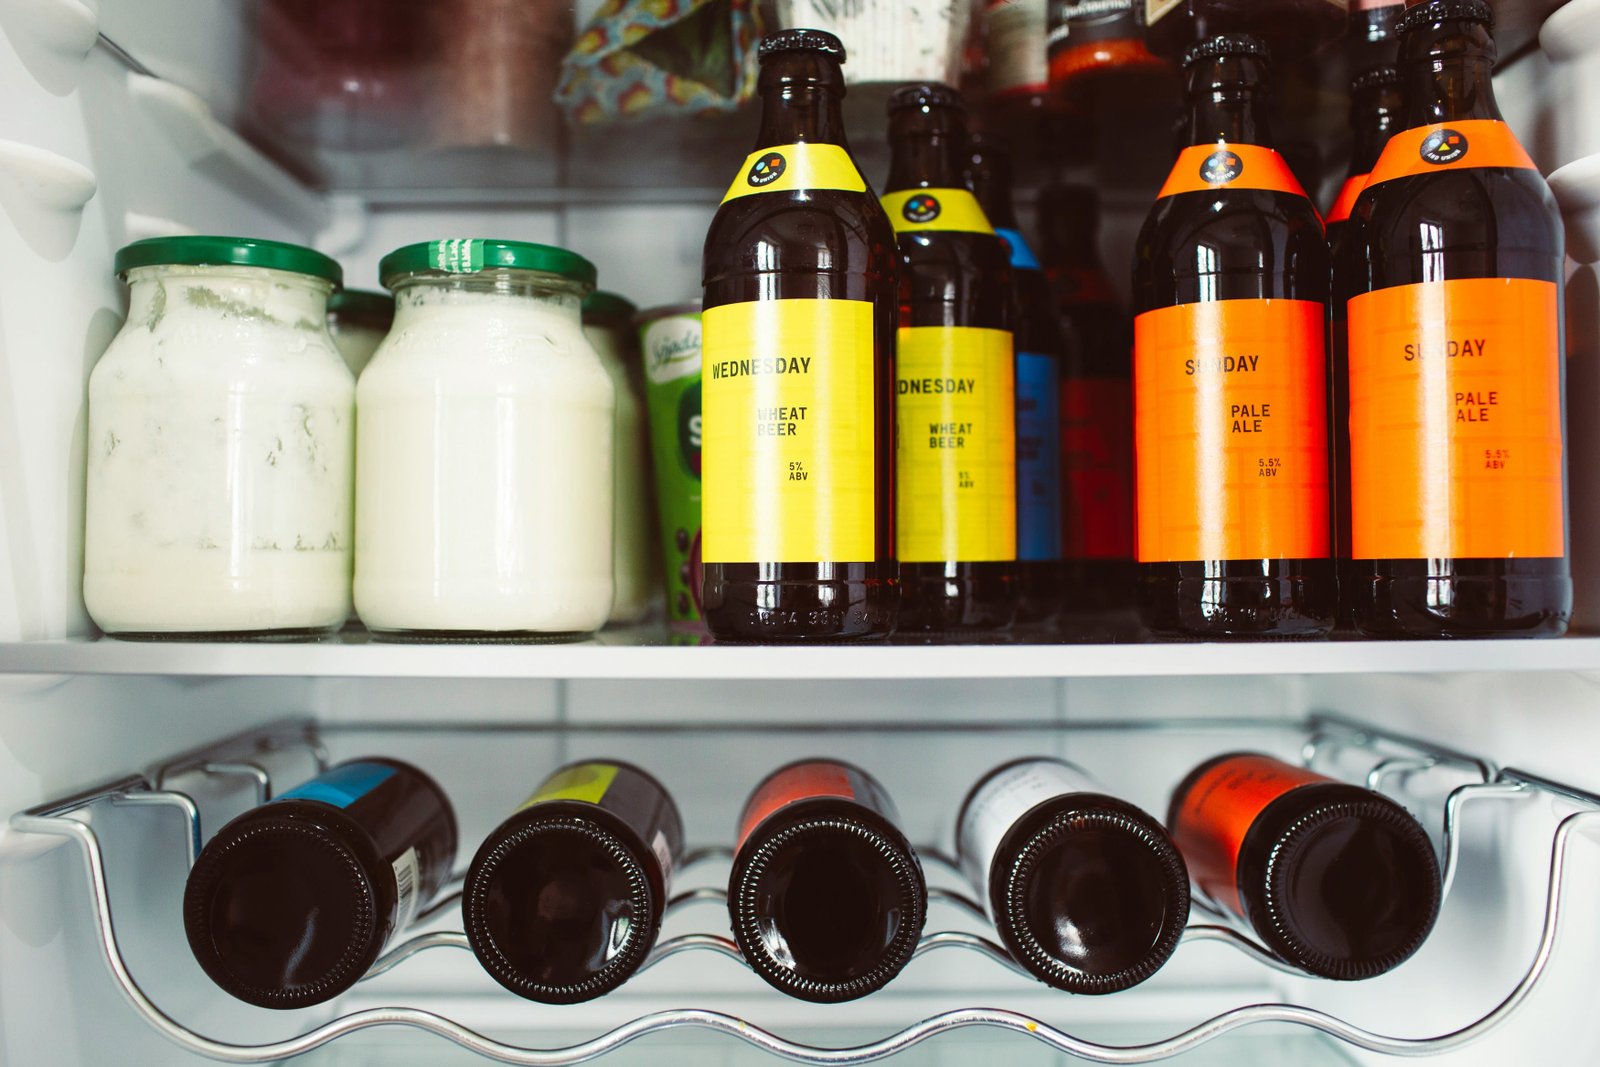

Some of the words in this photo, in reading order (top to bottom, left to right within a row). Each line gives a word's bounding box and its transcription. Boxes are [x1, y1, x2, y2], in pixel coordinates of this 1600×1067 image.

[1404, 339, 1486, 361] SDAY
[712, 357, 811, 379] WEDNESDAY
[1185, 355, 1259, 375] SDAY
[897, 379, 975, 394] DNESDAY
[1455, 391, 1498, 406] PALE
[757, 407, 807, 420] WHEAT
[1231, 404, 1270, 418] PALE
[1456, 408, 1489, 422] ALE
[757, 423, 796, 436] BEER
[929, 423, 973, 434] WHEAT
[1232, 420, 1262, 433] ALE
[929, 437, 964, 448] BEER
[789, 461, 803, 471] 5%
[1259, 458, 1281, 467] 5.5%
[789, 472, 808, 480] ABV
[1259, 468, 1277, 477] ABV
